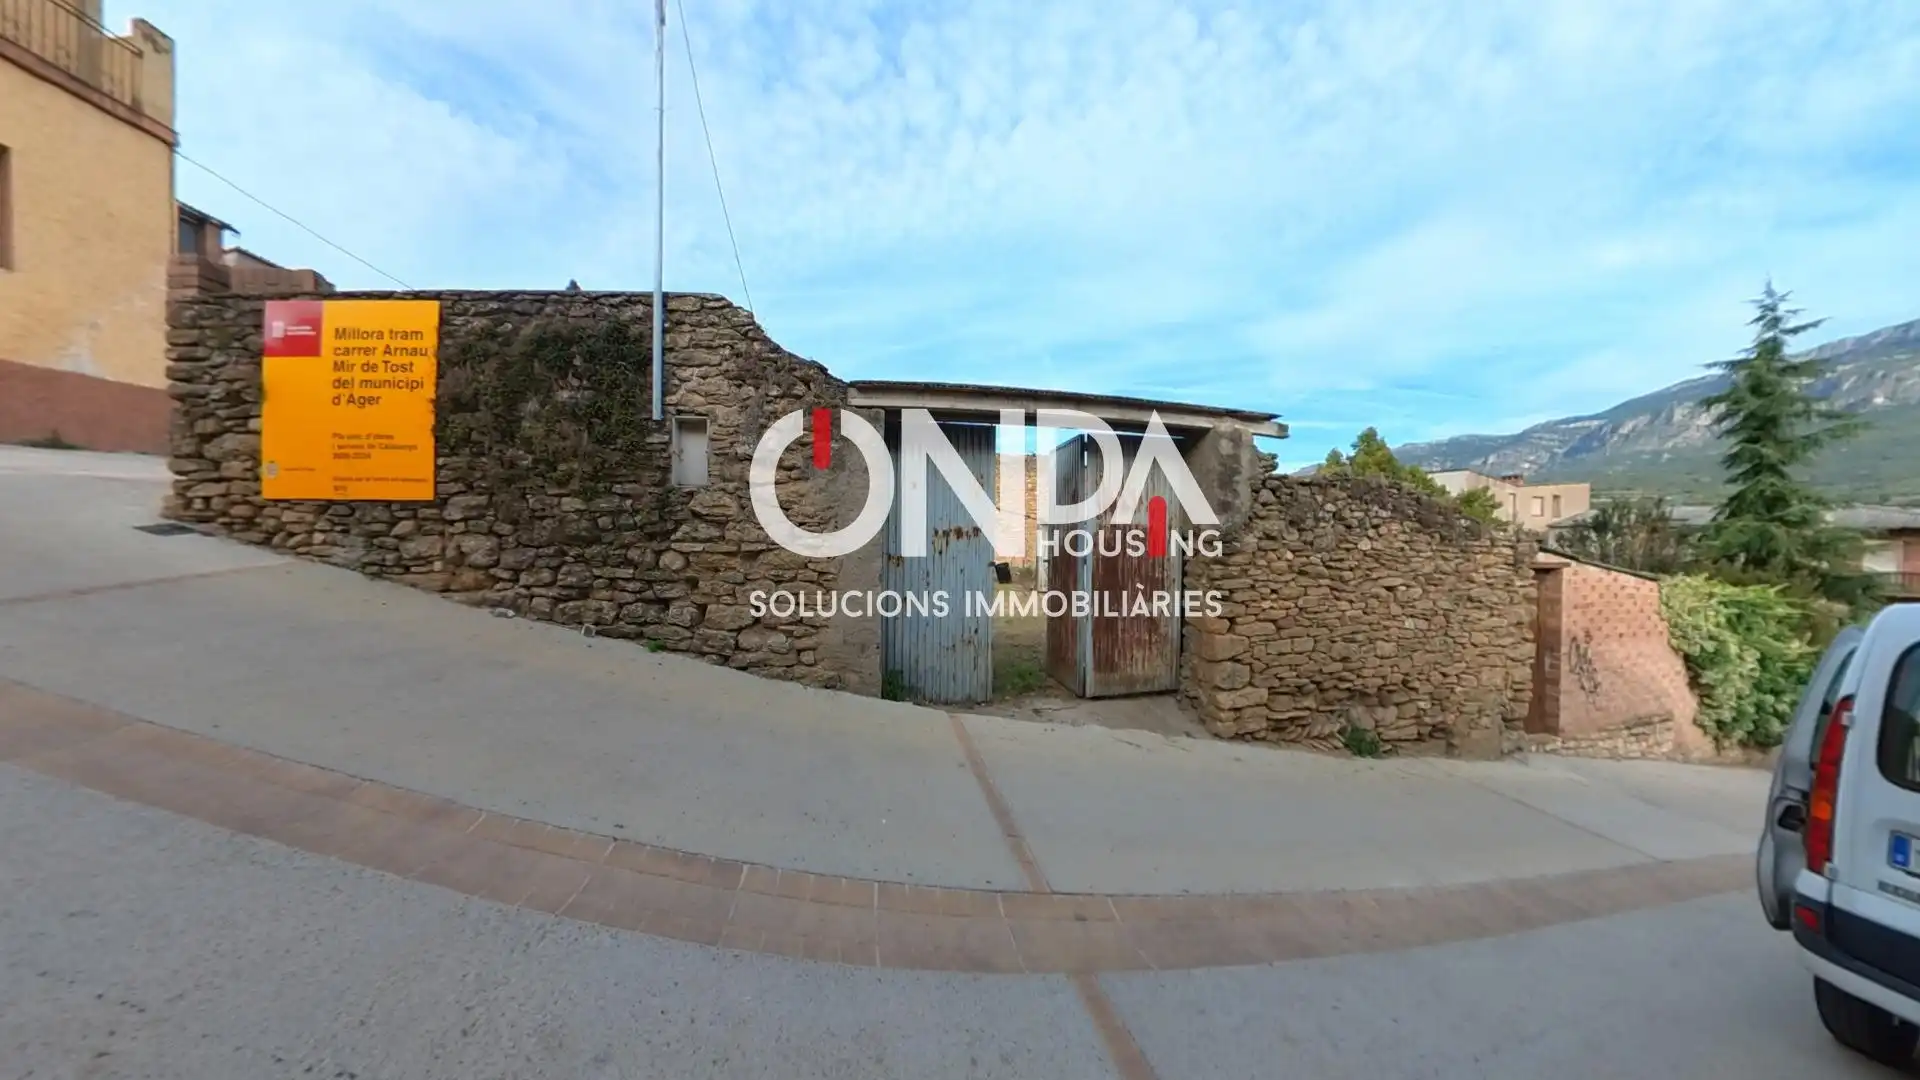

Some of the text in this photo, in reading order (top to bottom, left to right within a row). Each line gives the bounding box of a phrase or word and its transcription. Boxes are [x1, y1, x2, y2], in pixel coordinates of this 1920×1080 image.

[334, 328, 424, 341] Millora tram
[333, 344, 428, 357] carrer Arnau
[332, 360, 414, 373] Mir de Tost
[332, 377, 424, 392] del municipi
